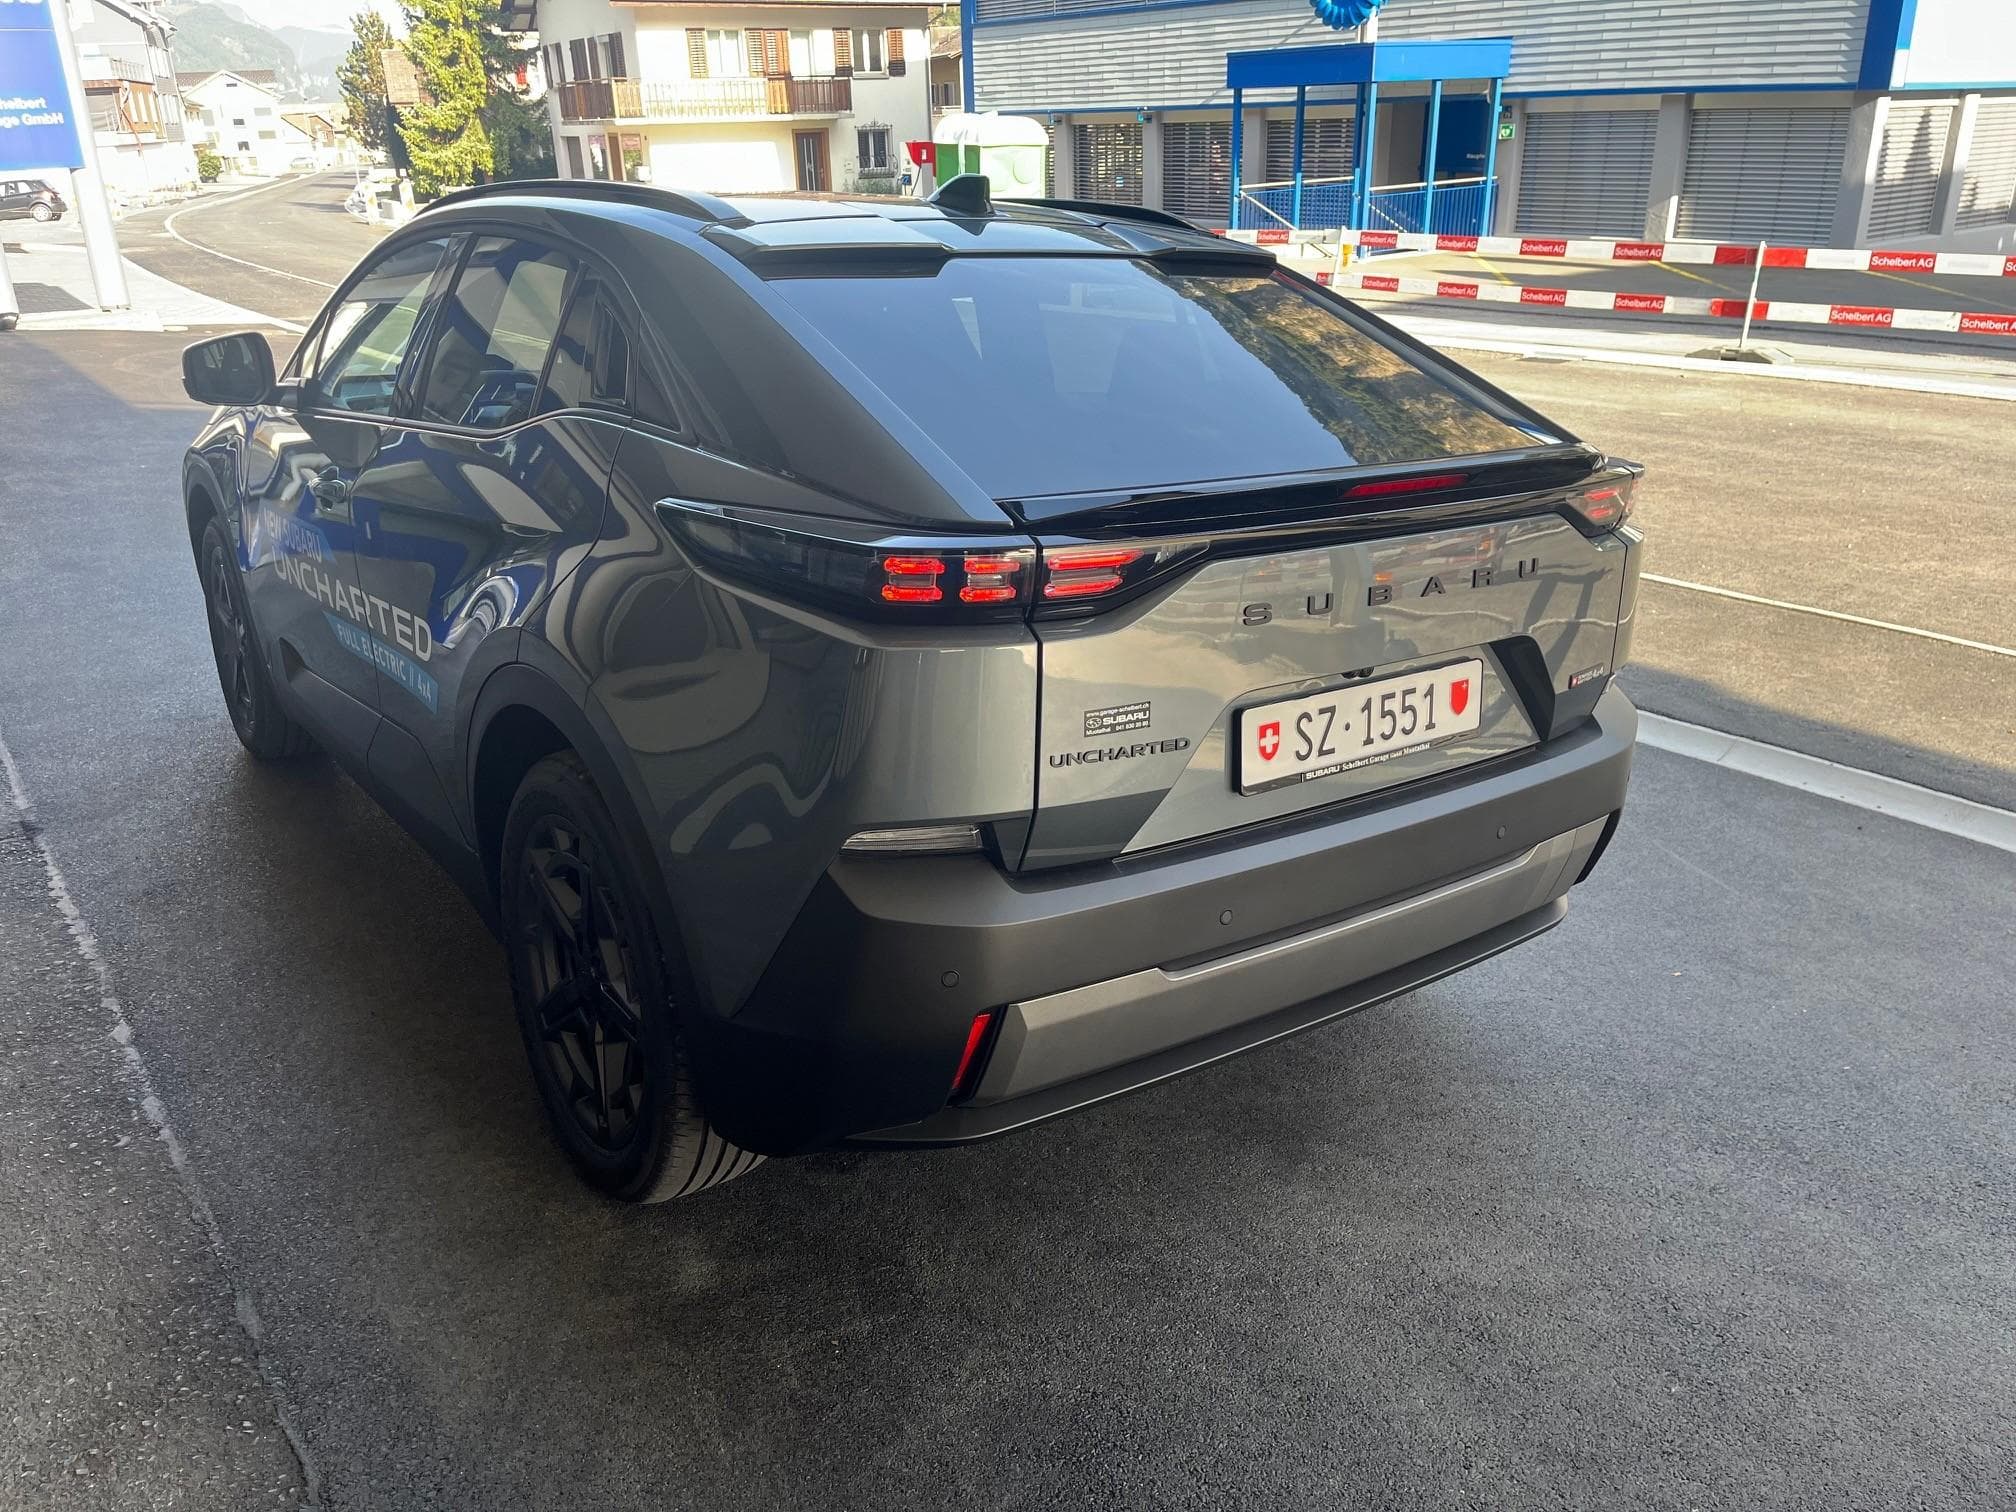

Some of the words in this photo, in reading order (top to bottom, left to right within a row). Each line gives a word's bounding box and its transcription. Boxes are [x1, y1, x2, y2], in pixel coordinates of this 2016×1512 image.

[21, 112, 64, 126] GmbH
[1280, 232, 1289, 241] AG
[1388, 235, 1397, 245] AG
[1466, 240, 1477, 249] AG
[1553, 244, 1565, 253] AG
[1650, 248, 1662, 257] AG
[1917, 257, 1934, 268] AG
[1388, 279, 1398, 289] AG
[1466, 287, 1477, 295] AG
[1553, 293, 1565, 302] AG
[1650, 299, 1663, 309] AG
[1875, 312, 1892, 323] AG
[2010, 321, 2016, 331] A
[282, 518, 322, 563] SUBARU
[1243, 557, 1539, 626] SUBARU
[271, 544, 432, 662] UNCHARTED
[337, 624, 361, 651] FULL
[361, 637, 406, 681] ELECTRIC
[1102, 711, 1149, 725] SUBARU
[1049, 737, 1191, 768] UNCHARTED
[1306, 765, 1340, 780] SUBARU
[1369, 751, 1389, 765] Garage
